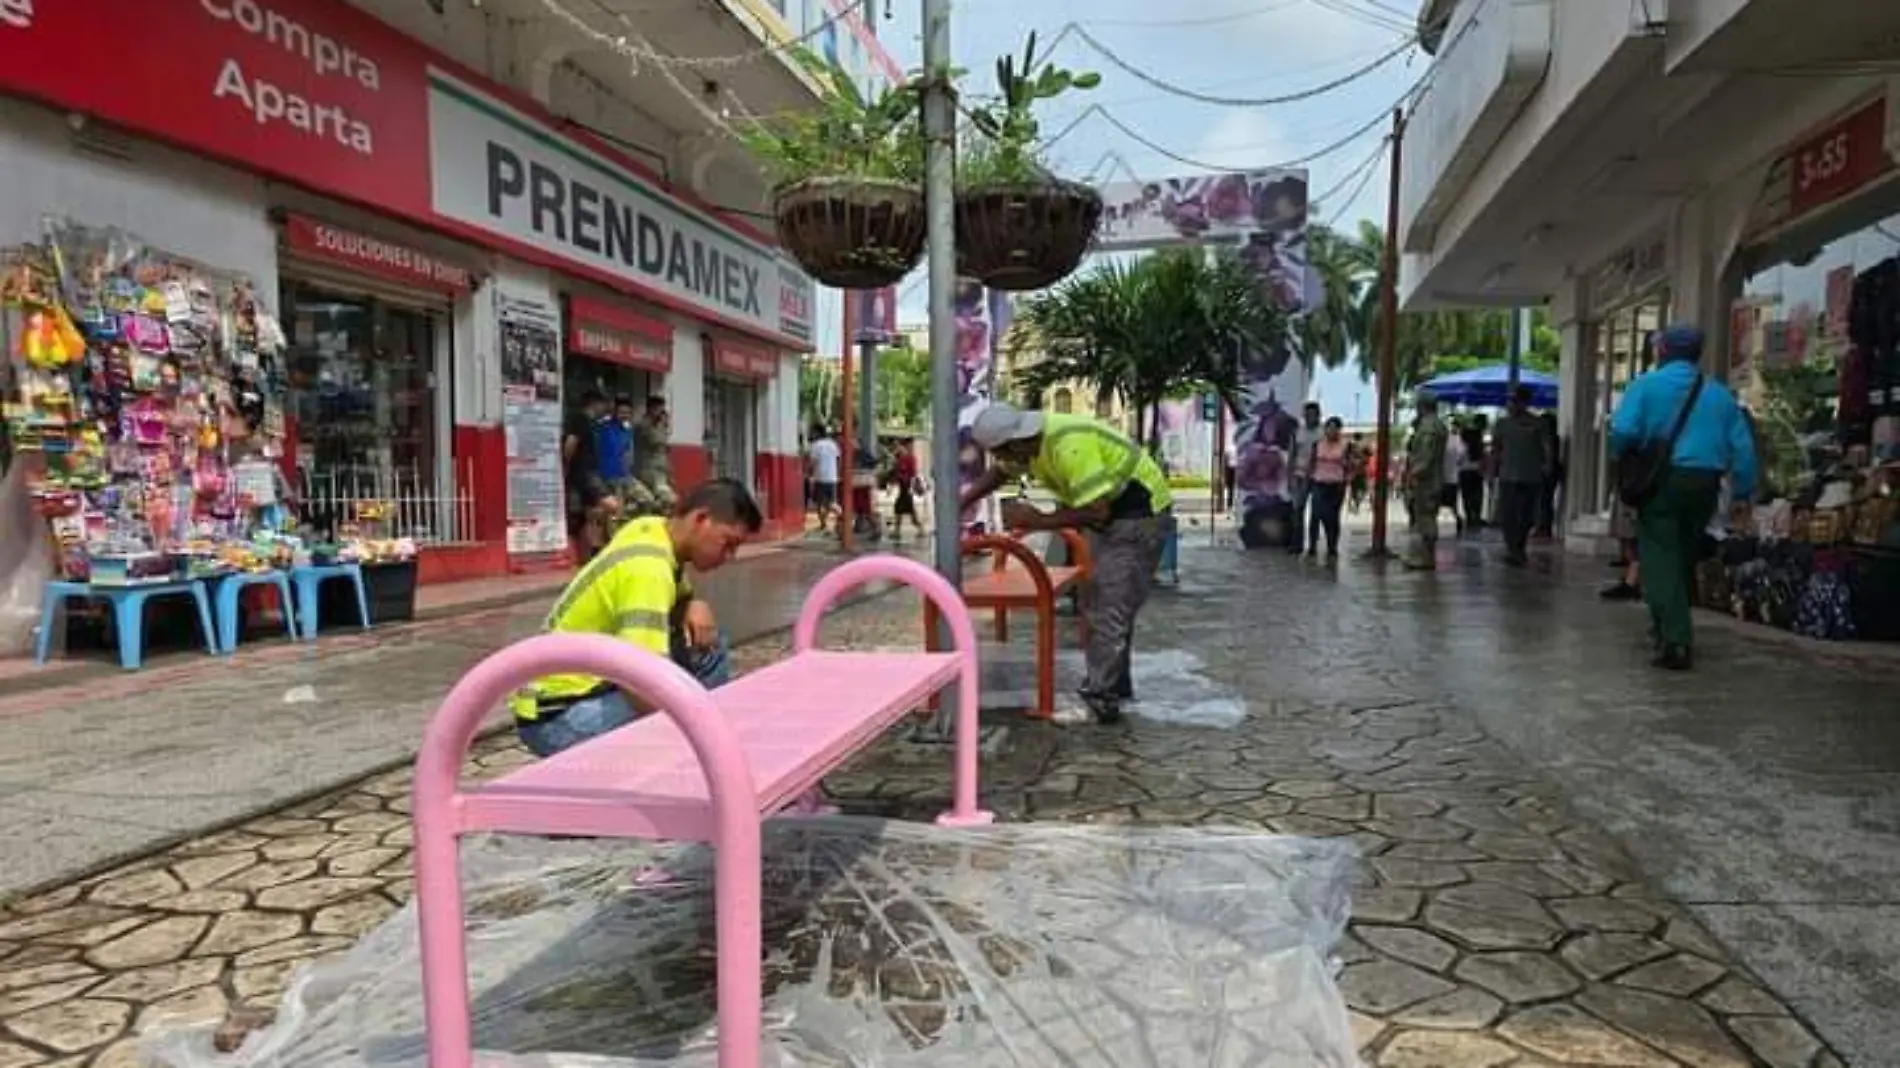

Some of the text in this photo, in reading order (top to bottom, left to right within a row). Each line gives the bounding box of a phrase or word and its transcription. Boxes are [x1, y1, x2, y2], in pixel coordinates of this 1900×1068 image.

[213, 59, 374, 155] Aparta
[315, 225, 410, 269] SOLUCIONES
[486, 139, 761, 317] PRENDAMEX
